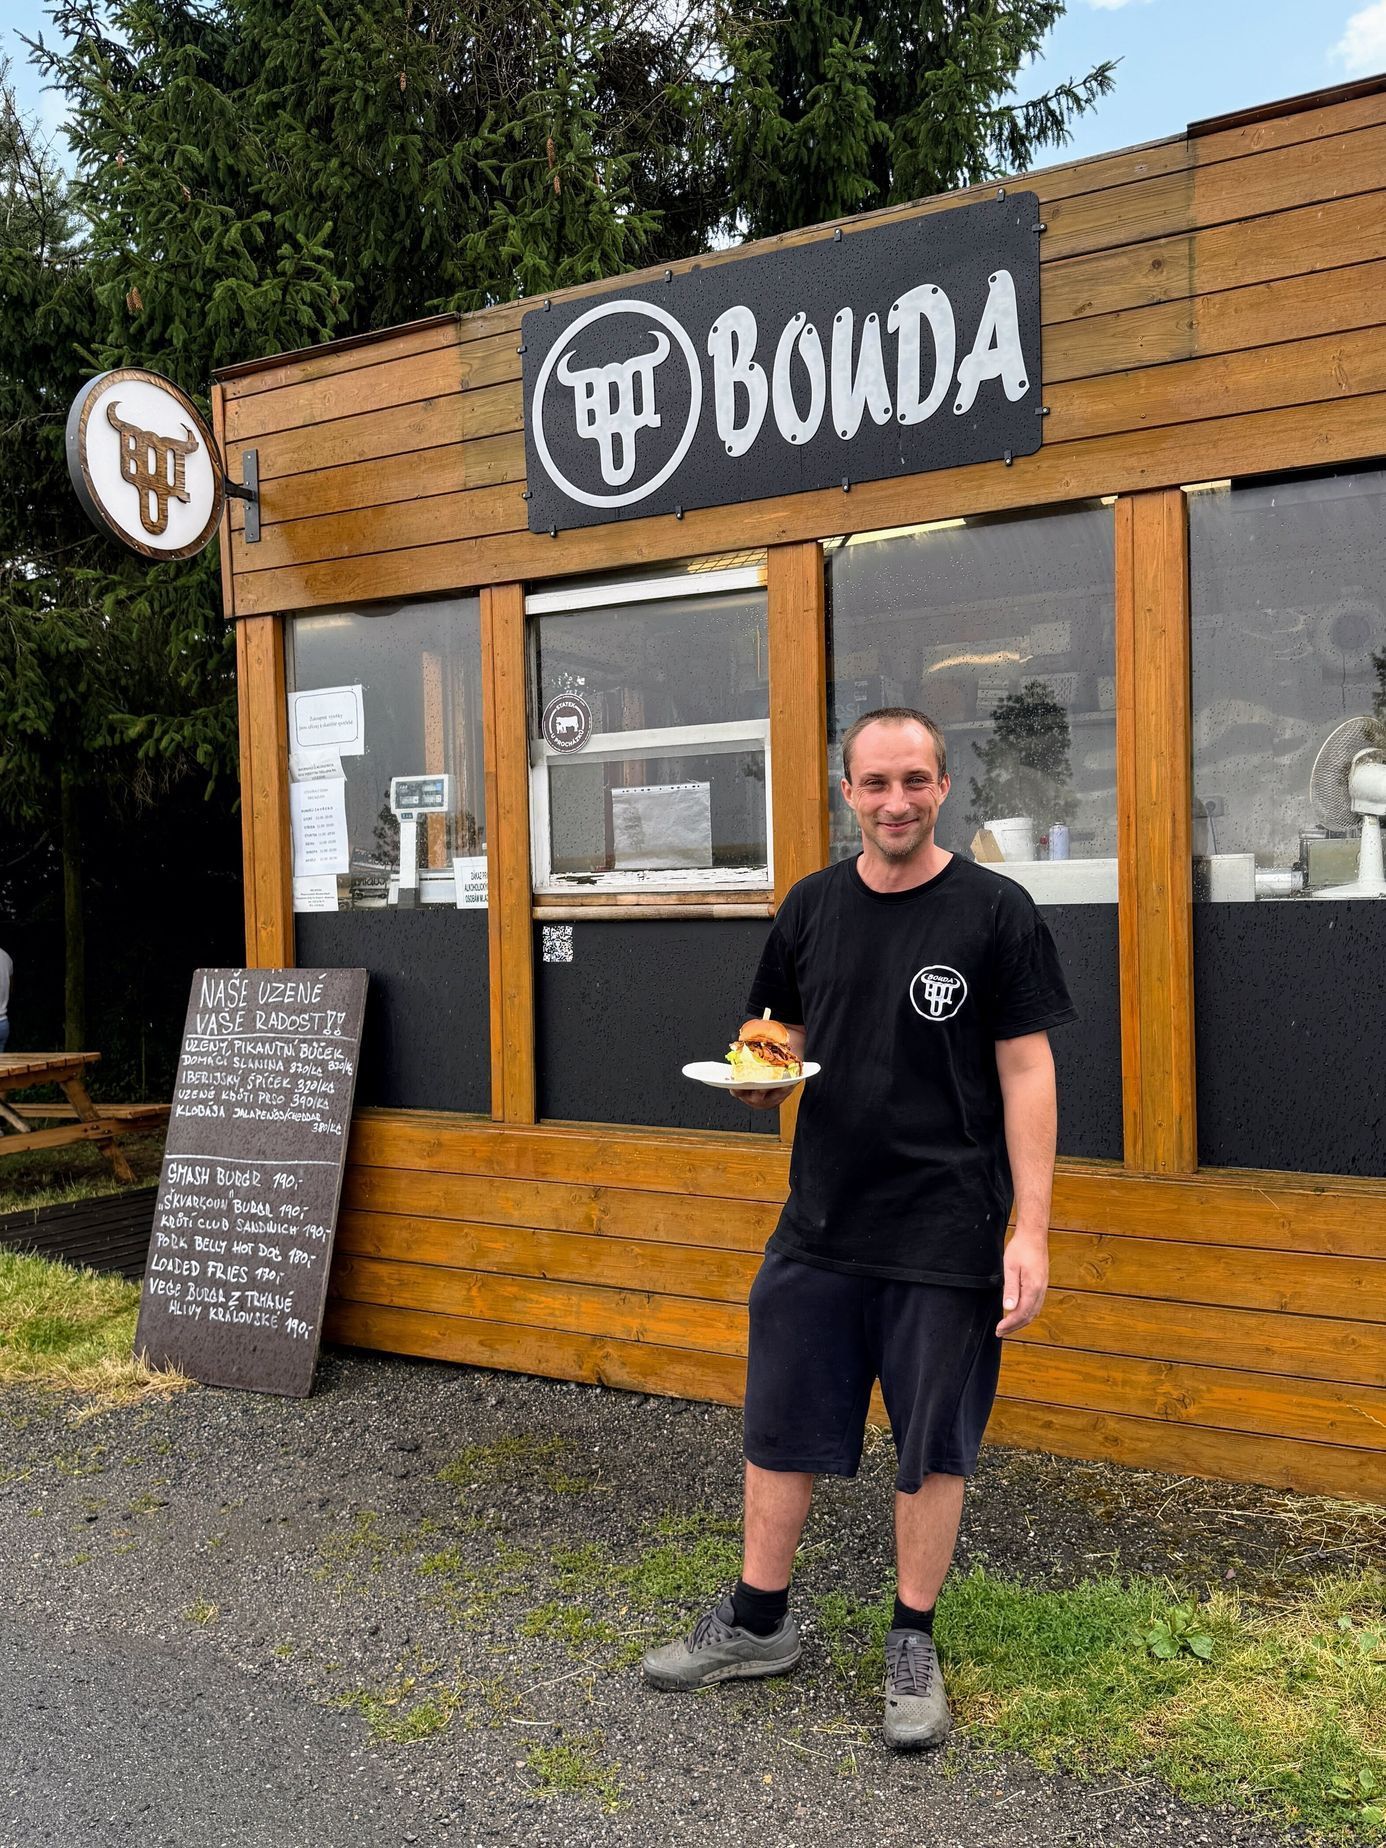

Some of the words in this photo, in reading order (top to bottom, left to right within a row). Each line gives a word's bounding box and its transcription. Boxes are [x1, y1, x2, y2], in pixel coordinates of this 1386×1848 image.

[708, 269, 1031, 458] BOUDA
[200, 971, 249, 1009] NAŠE
[259, 973, 327, 1004] UZENÉ
[927, 973, 954, 984] BOUDA
[196, 1008, 246, 1036] VAŠE
[233, 1056, 284, 1071] SLANINA
[182, 1069, 242, 1091] IBERIJSKÝ
[175, 1101, 225, 1118] KLOBÁSA
[258, 1091, 285, 1105] PRSO
[168, 1162, 210, 1186] SMASH
[216, 1166, 261, 1187] BURGR
[197, 1217, 229, 1231] CLUB
[236, 1218, 299, 1235] SANDWICH
[156, 1232, 188, 1249] PORK
[194, 1235, 227, 1254] BELLY
[232, 1240, 255, 1254] HOT
[258, 1243, 282, 1262] DOG
[151, 1253, 200, 1276] LOADED
[207, 1261, 248, 1283] FRIES
[228, 1292, 241, 1306] Z
[169, 1300, 202, 1320] HLIVY
[209, 1306, 280, 1328] KRÁLOVSKÉ
